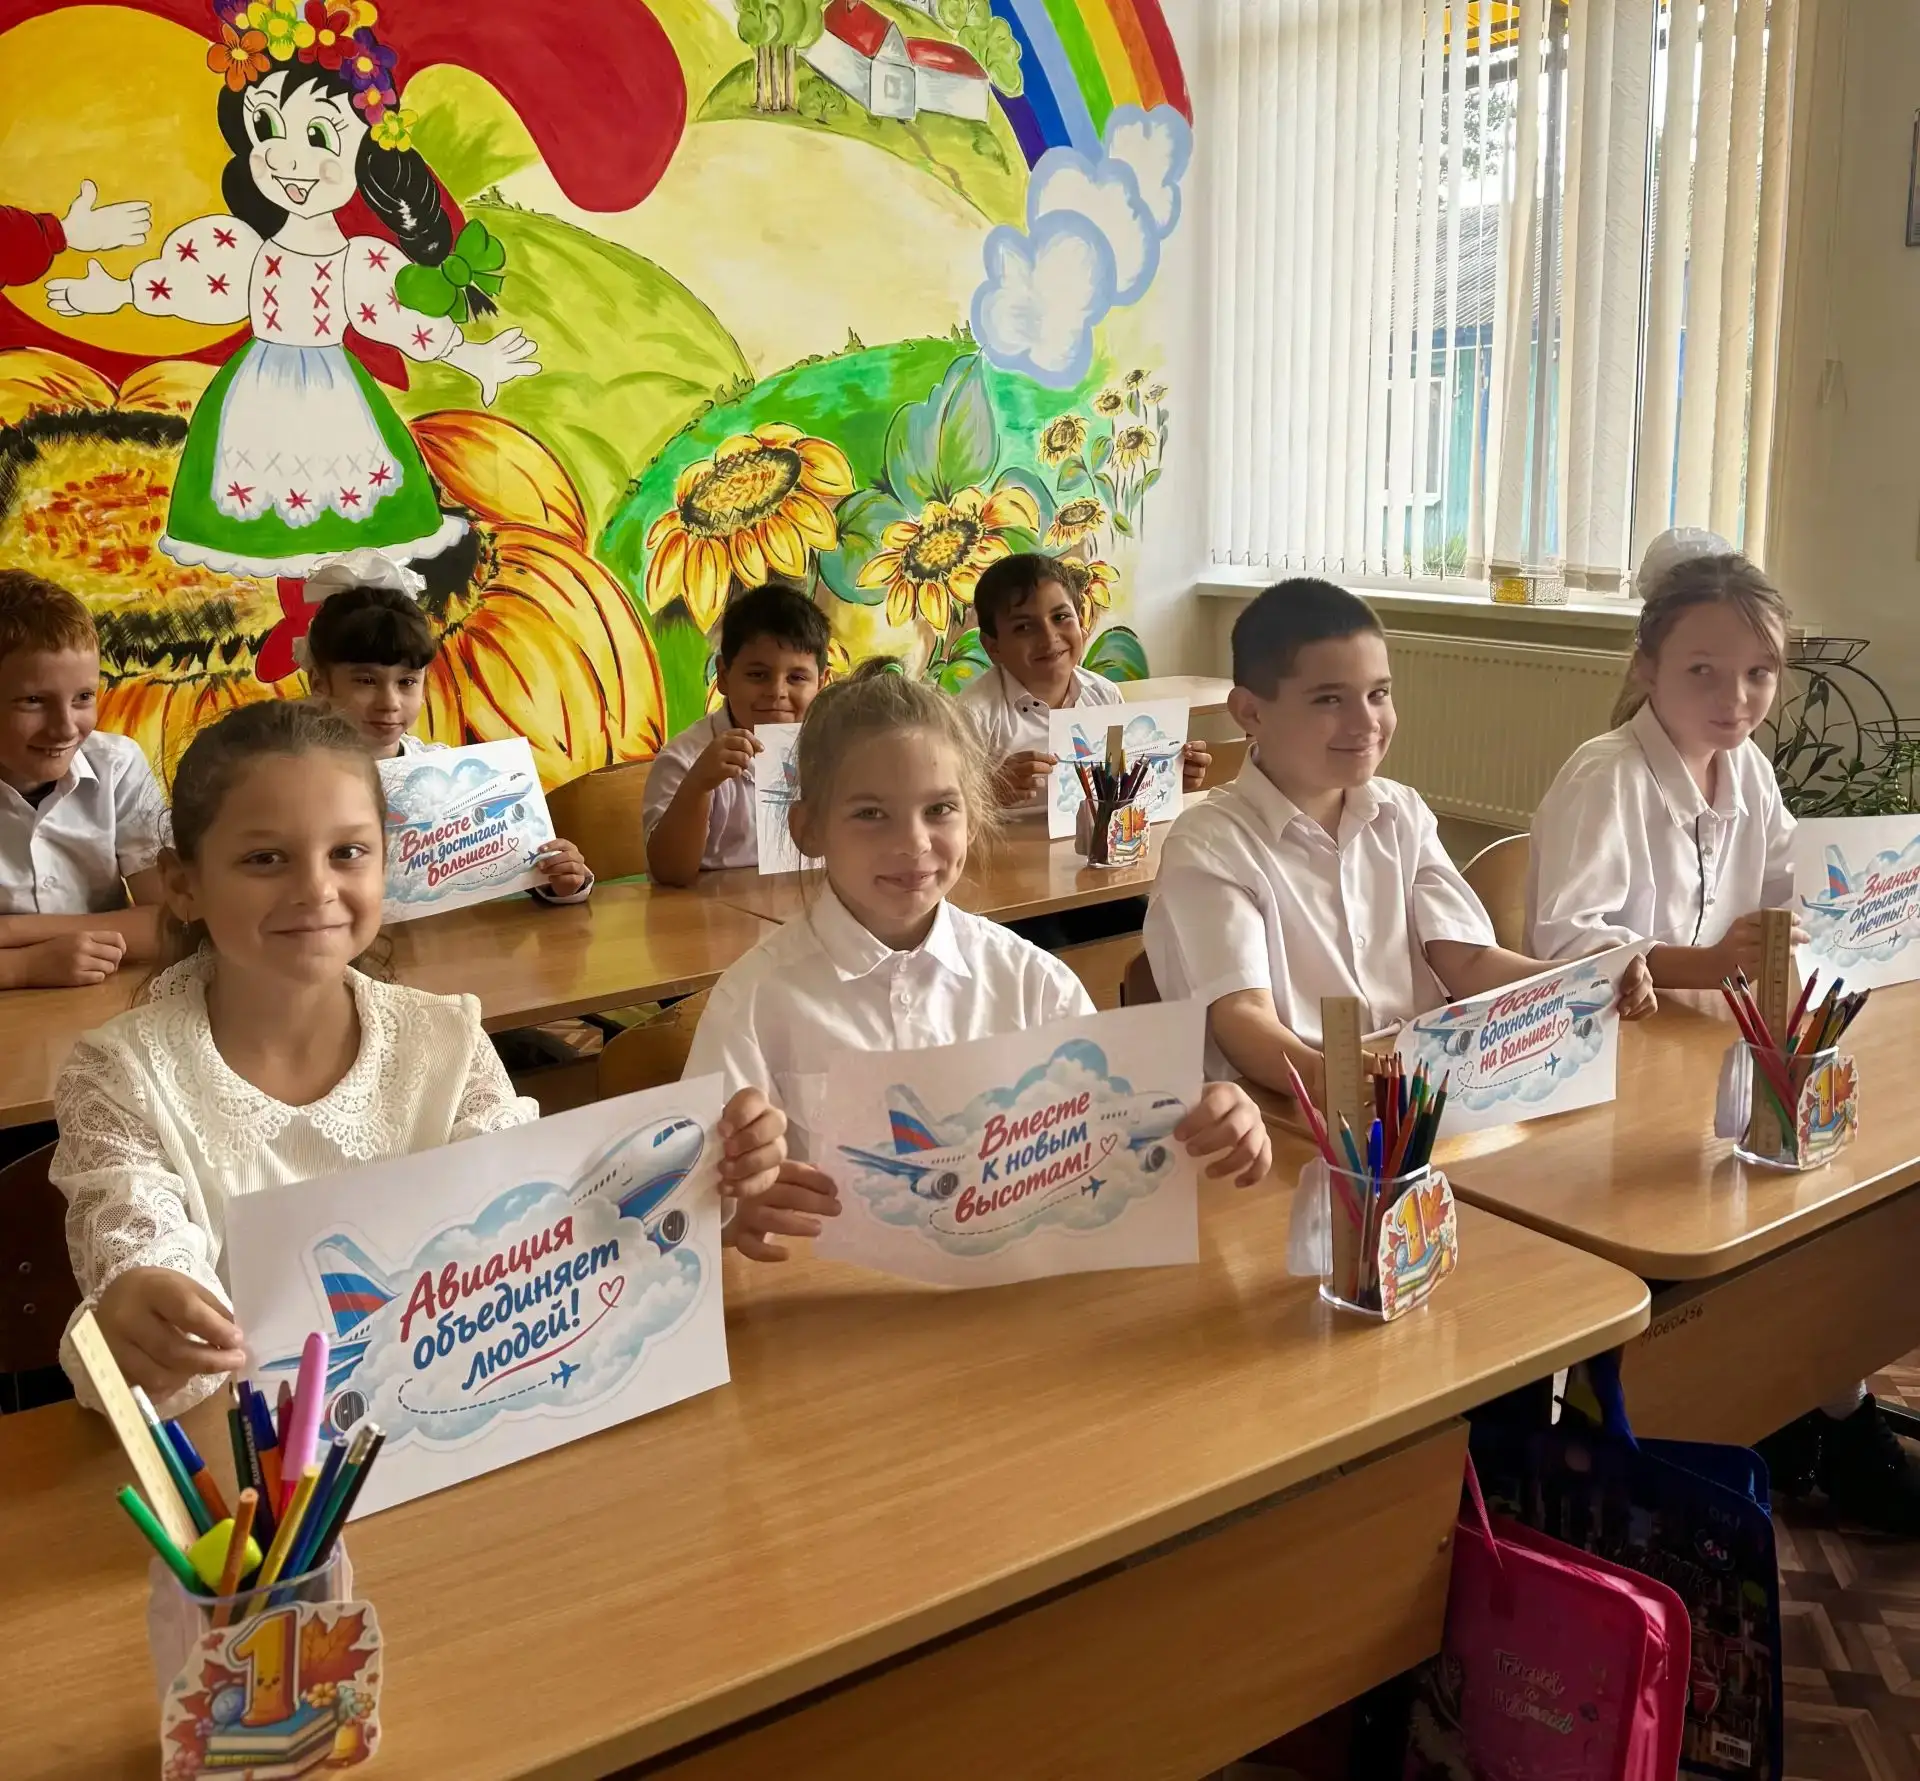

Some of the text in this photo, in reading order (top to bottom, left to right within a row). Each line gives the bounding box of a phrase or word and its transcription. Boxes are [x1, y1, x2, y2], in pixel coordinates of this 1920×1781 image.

[399, 816, 472, 862] Вместе
[404, 819, 509, 875] мы достигаем
[427, 834, 505, 887] большего!
[1849, 883, 1919, 924] окрыляют
[1857, 866, 1920, 905] Знания
[1849, 899, 1908, 942] мечты!
[1479, 994, 1565, 1051] вдохновляет
[1486, 978, 1564, 1023] Россия
[1480, 1015, 1556, 1074] на большее!
[978, 1091, 1091, 1161] Вместе
[982, 1121, 1089, 1185] к новым
[954, 1143, 1093, 1224] высотам!
[400, 1216, 574, 1343] Авиация
[413, 1239, 621, 1371] объединяет
[461, 1288, 581, 1391] людей!
